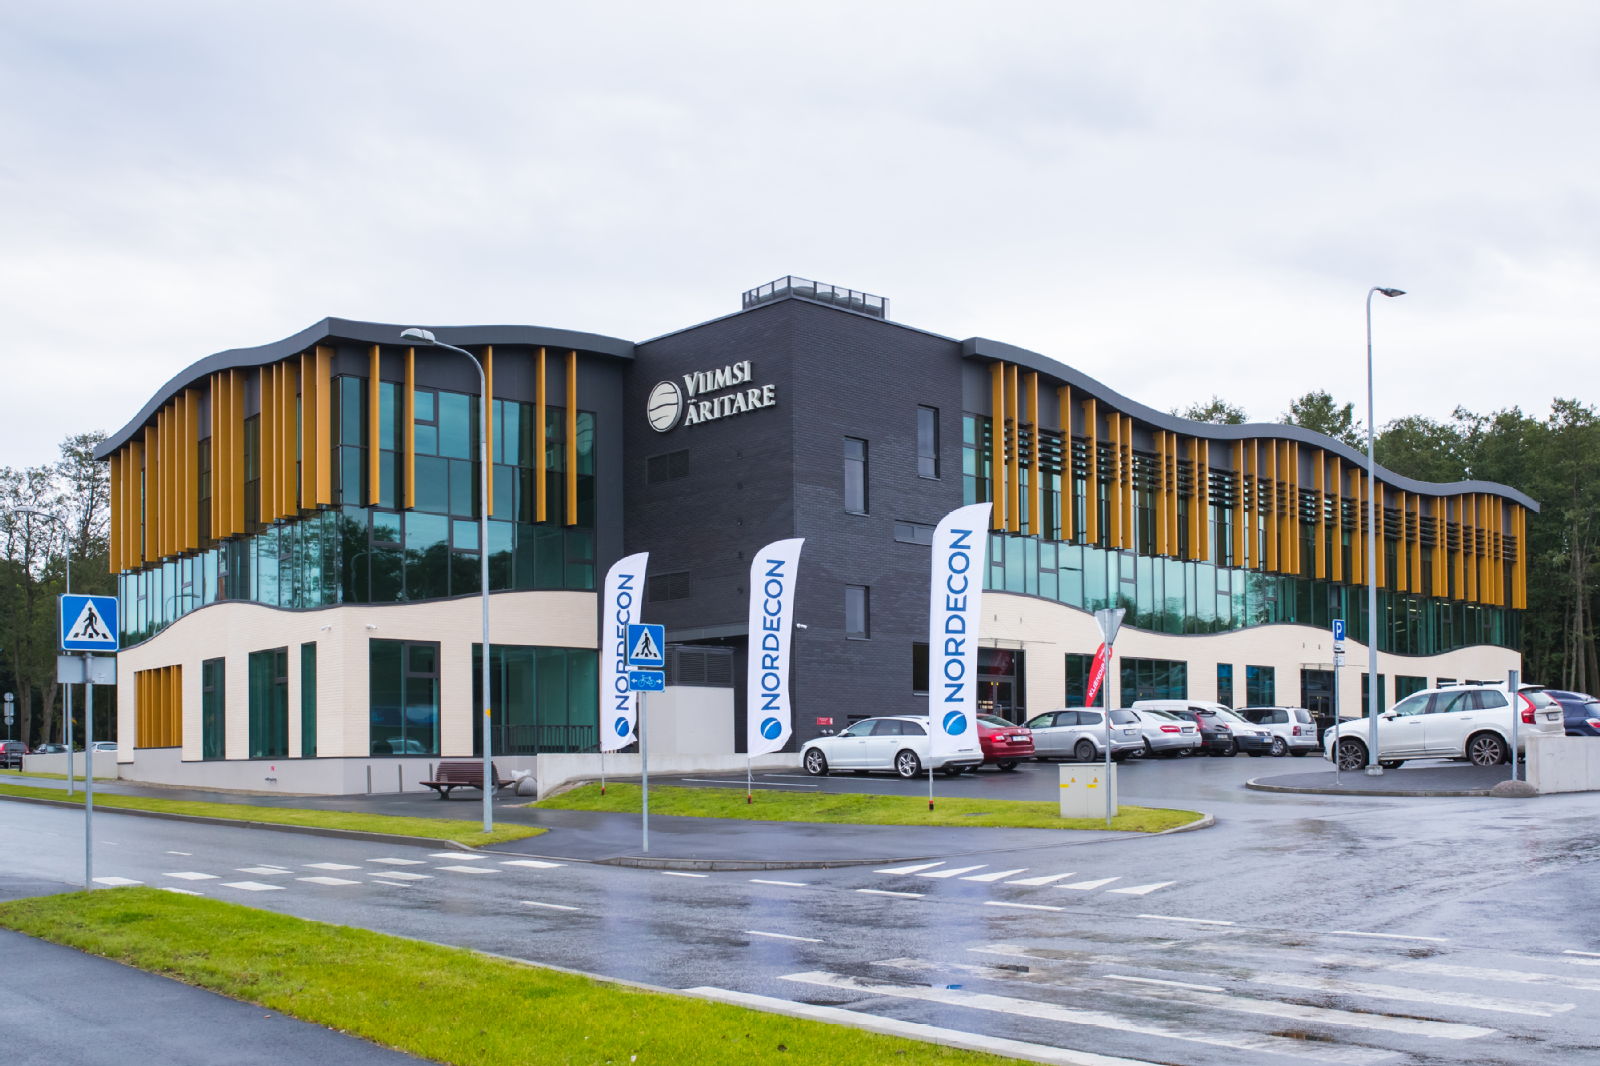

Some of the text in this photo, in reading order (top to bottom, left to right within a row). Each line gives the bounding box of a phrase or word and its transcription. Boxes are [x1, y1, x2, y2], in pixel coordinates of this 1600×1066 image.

[683, 360, 752, 397] VIIMSI
[684, 384, 776, 426] ÄRITARE
[761, 559, 786, 711] NORDECON
[944, 529, 973, 703] NORDECON
[1336, 622, 1343, 639] P
